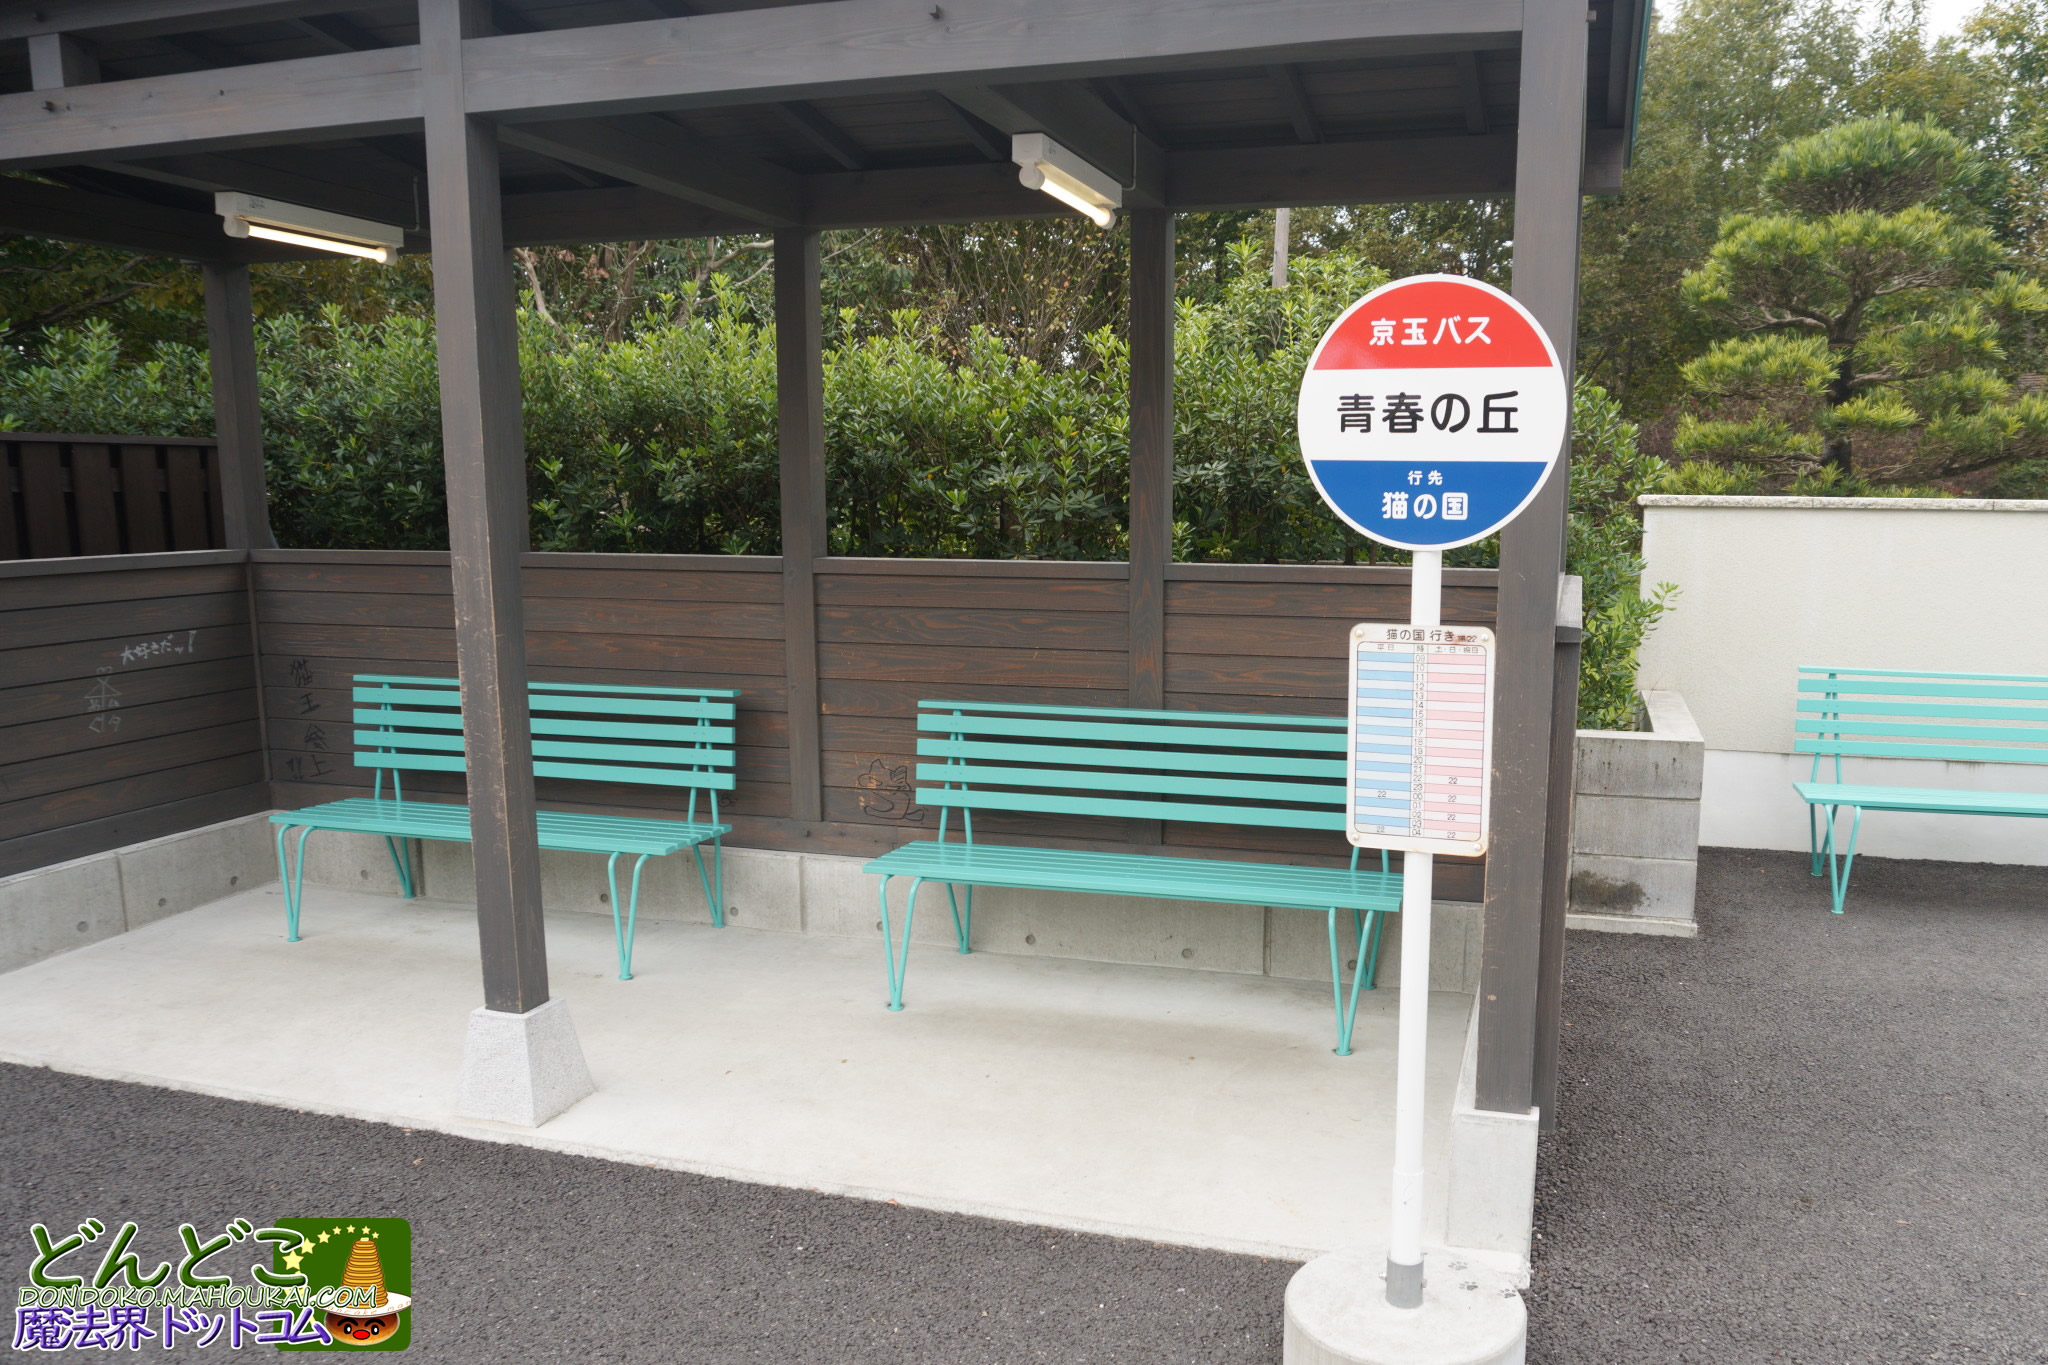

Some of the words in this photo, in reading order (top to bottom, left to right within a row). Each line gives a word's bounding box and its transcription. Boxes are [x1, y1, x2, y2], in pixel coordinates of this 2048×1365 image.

[1369, 315, 1491, 345] 京玉バス
[1337, 390, 1519, 434] 青春の丘
[1407, 470, 1443, 486] 行先
[1382, 491, 1469, 520] 猫の国
[1386, 628, 1425, 642] 猫の国
[1430, 629, 1455, 643] 行き
[1415, 664, 1425, 672] 10
[1416, 673, 1425, 682] 11
[1415, 682, 1424, 691] 12
[1415, 692, 1424, 700] 13
[1415, 700, 1424, 709] 14
[1414, 710, 1424, 718] 15
[1414, 719, 1424, 728] 16
[1414, 747, 1423, 755] 19
[1413, 756, 1423, 764] 20
[1413, 765, 1422, 773] 21
[1412, 774, 1422, 782] 22
[1413, 783, 1423, 791] 23
[1377, 790, 1387, 798] 22
[1412, 792, 1423, 800] 00
[1447, 795, 1457, 803] 22
[1447, 813, 1457, 821] 22
[1446, 831, 1456, 839] 22
